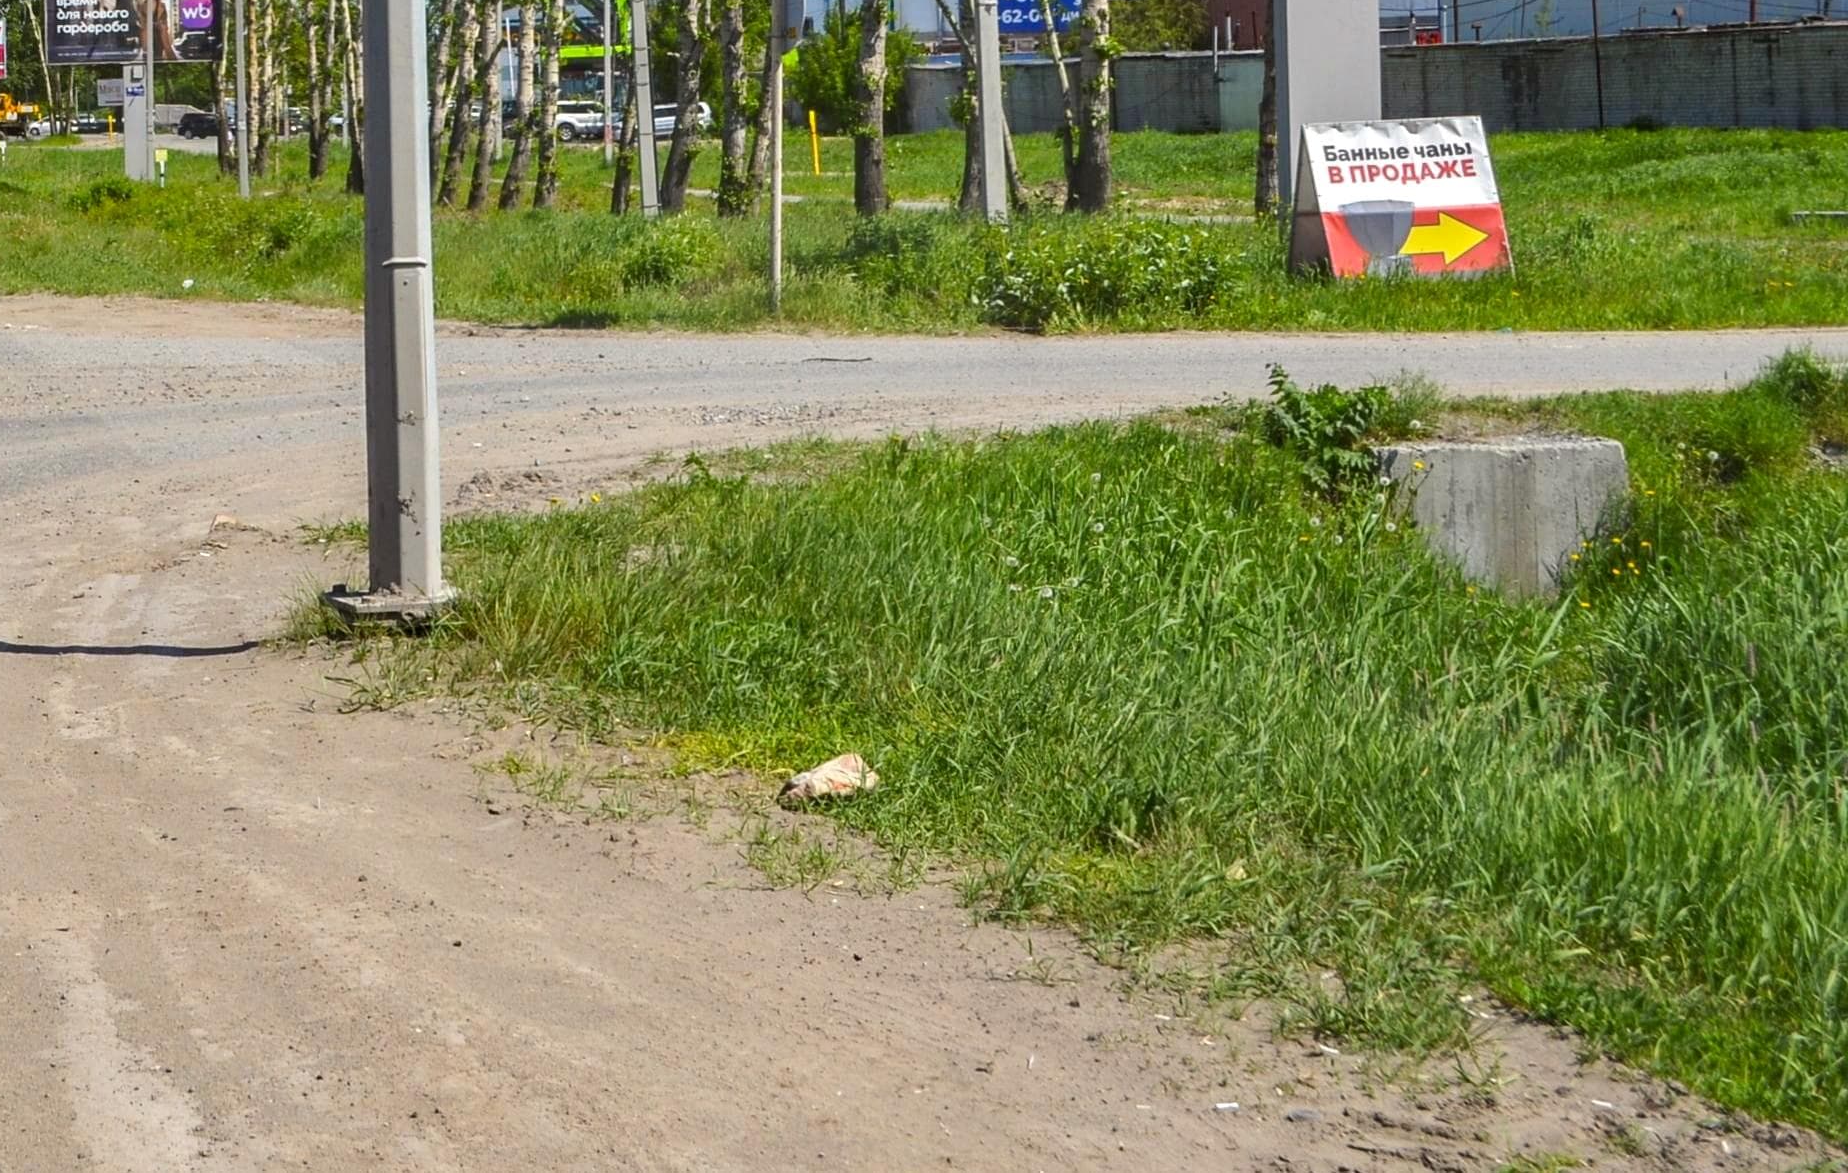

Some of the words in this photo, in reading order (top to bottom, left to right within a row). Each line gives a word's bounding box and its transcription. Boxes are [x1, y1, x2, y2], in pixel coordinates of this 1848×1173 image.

[56, 8, 81, 20] для
[83, 9, 129, 19] нового
[182, 3, 211, 19] wb
[56, 22, 129, 36] гардероба
[1323, 145, 1410, 162] Банные
[1414, 142, 1472, 159] чаны
[1328, 166, 1345, 184] В
[1349, 159, 1477, 185] ПРОДАЖЕ
